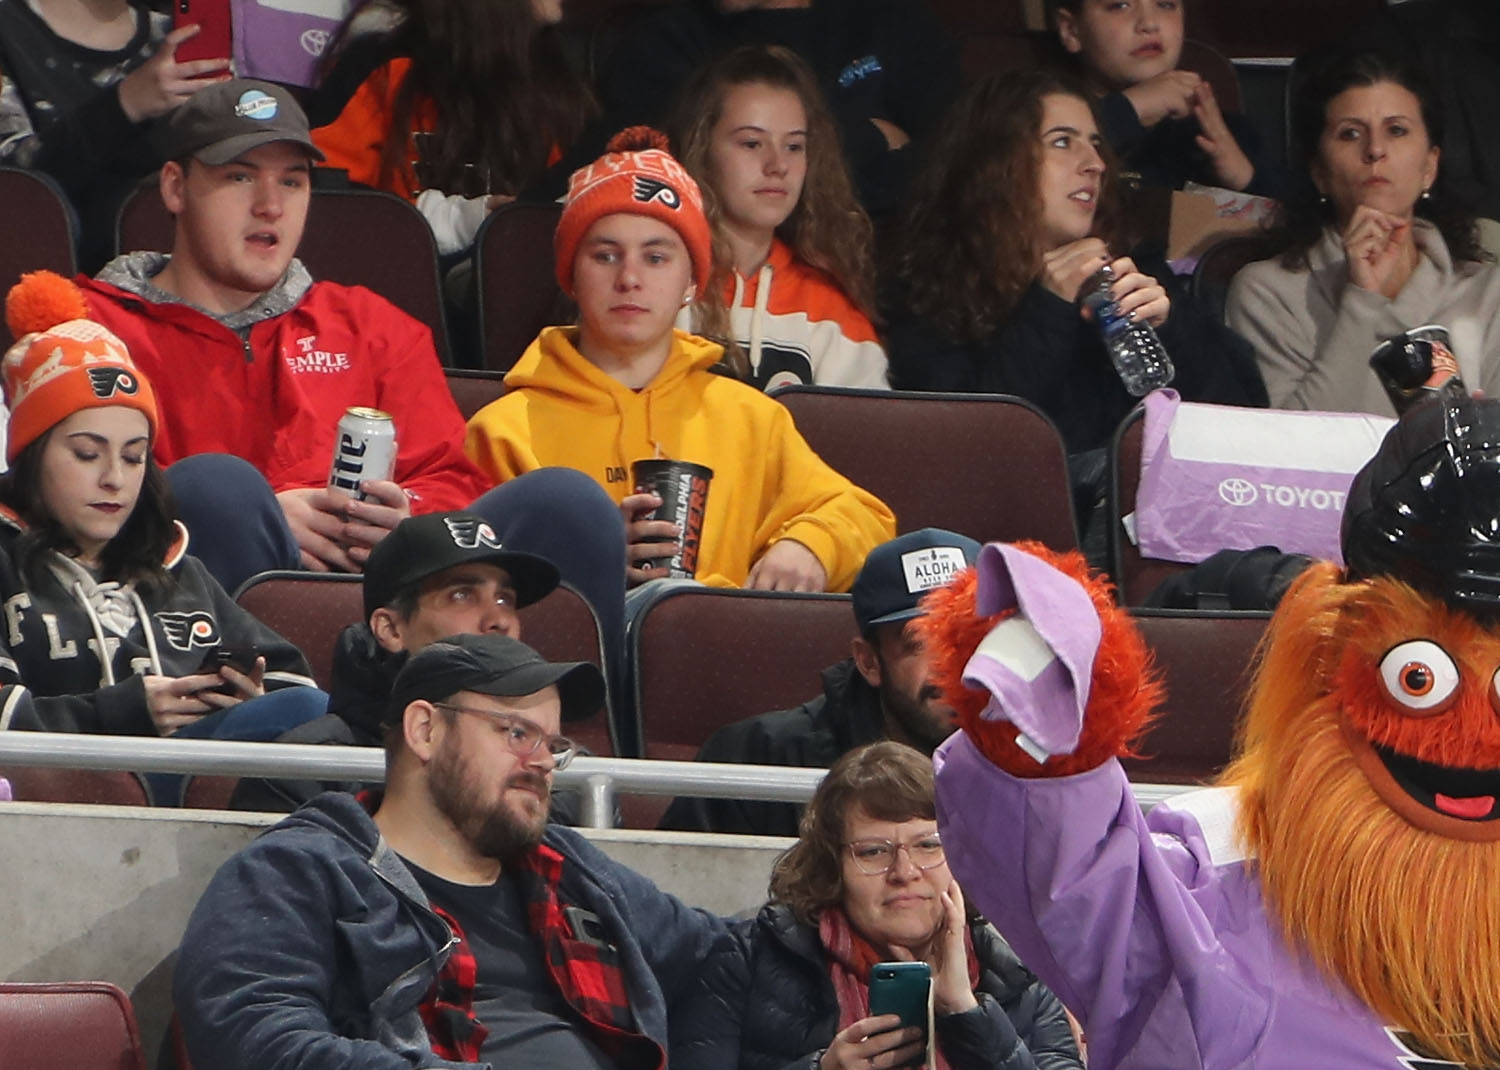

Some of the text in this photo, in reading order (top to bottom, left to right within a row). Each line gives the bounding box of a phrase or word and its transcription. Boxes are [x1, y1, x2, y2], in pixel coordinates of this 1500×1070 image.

[284, 351, 348, 367] EMPLE
[1260, 483, 1345, 511] TOYOT
[671, 474, 691, 568] PHLADELPHIA
[915, 562, 959, 578] ALOHA
